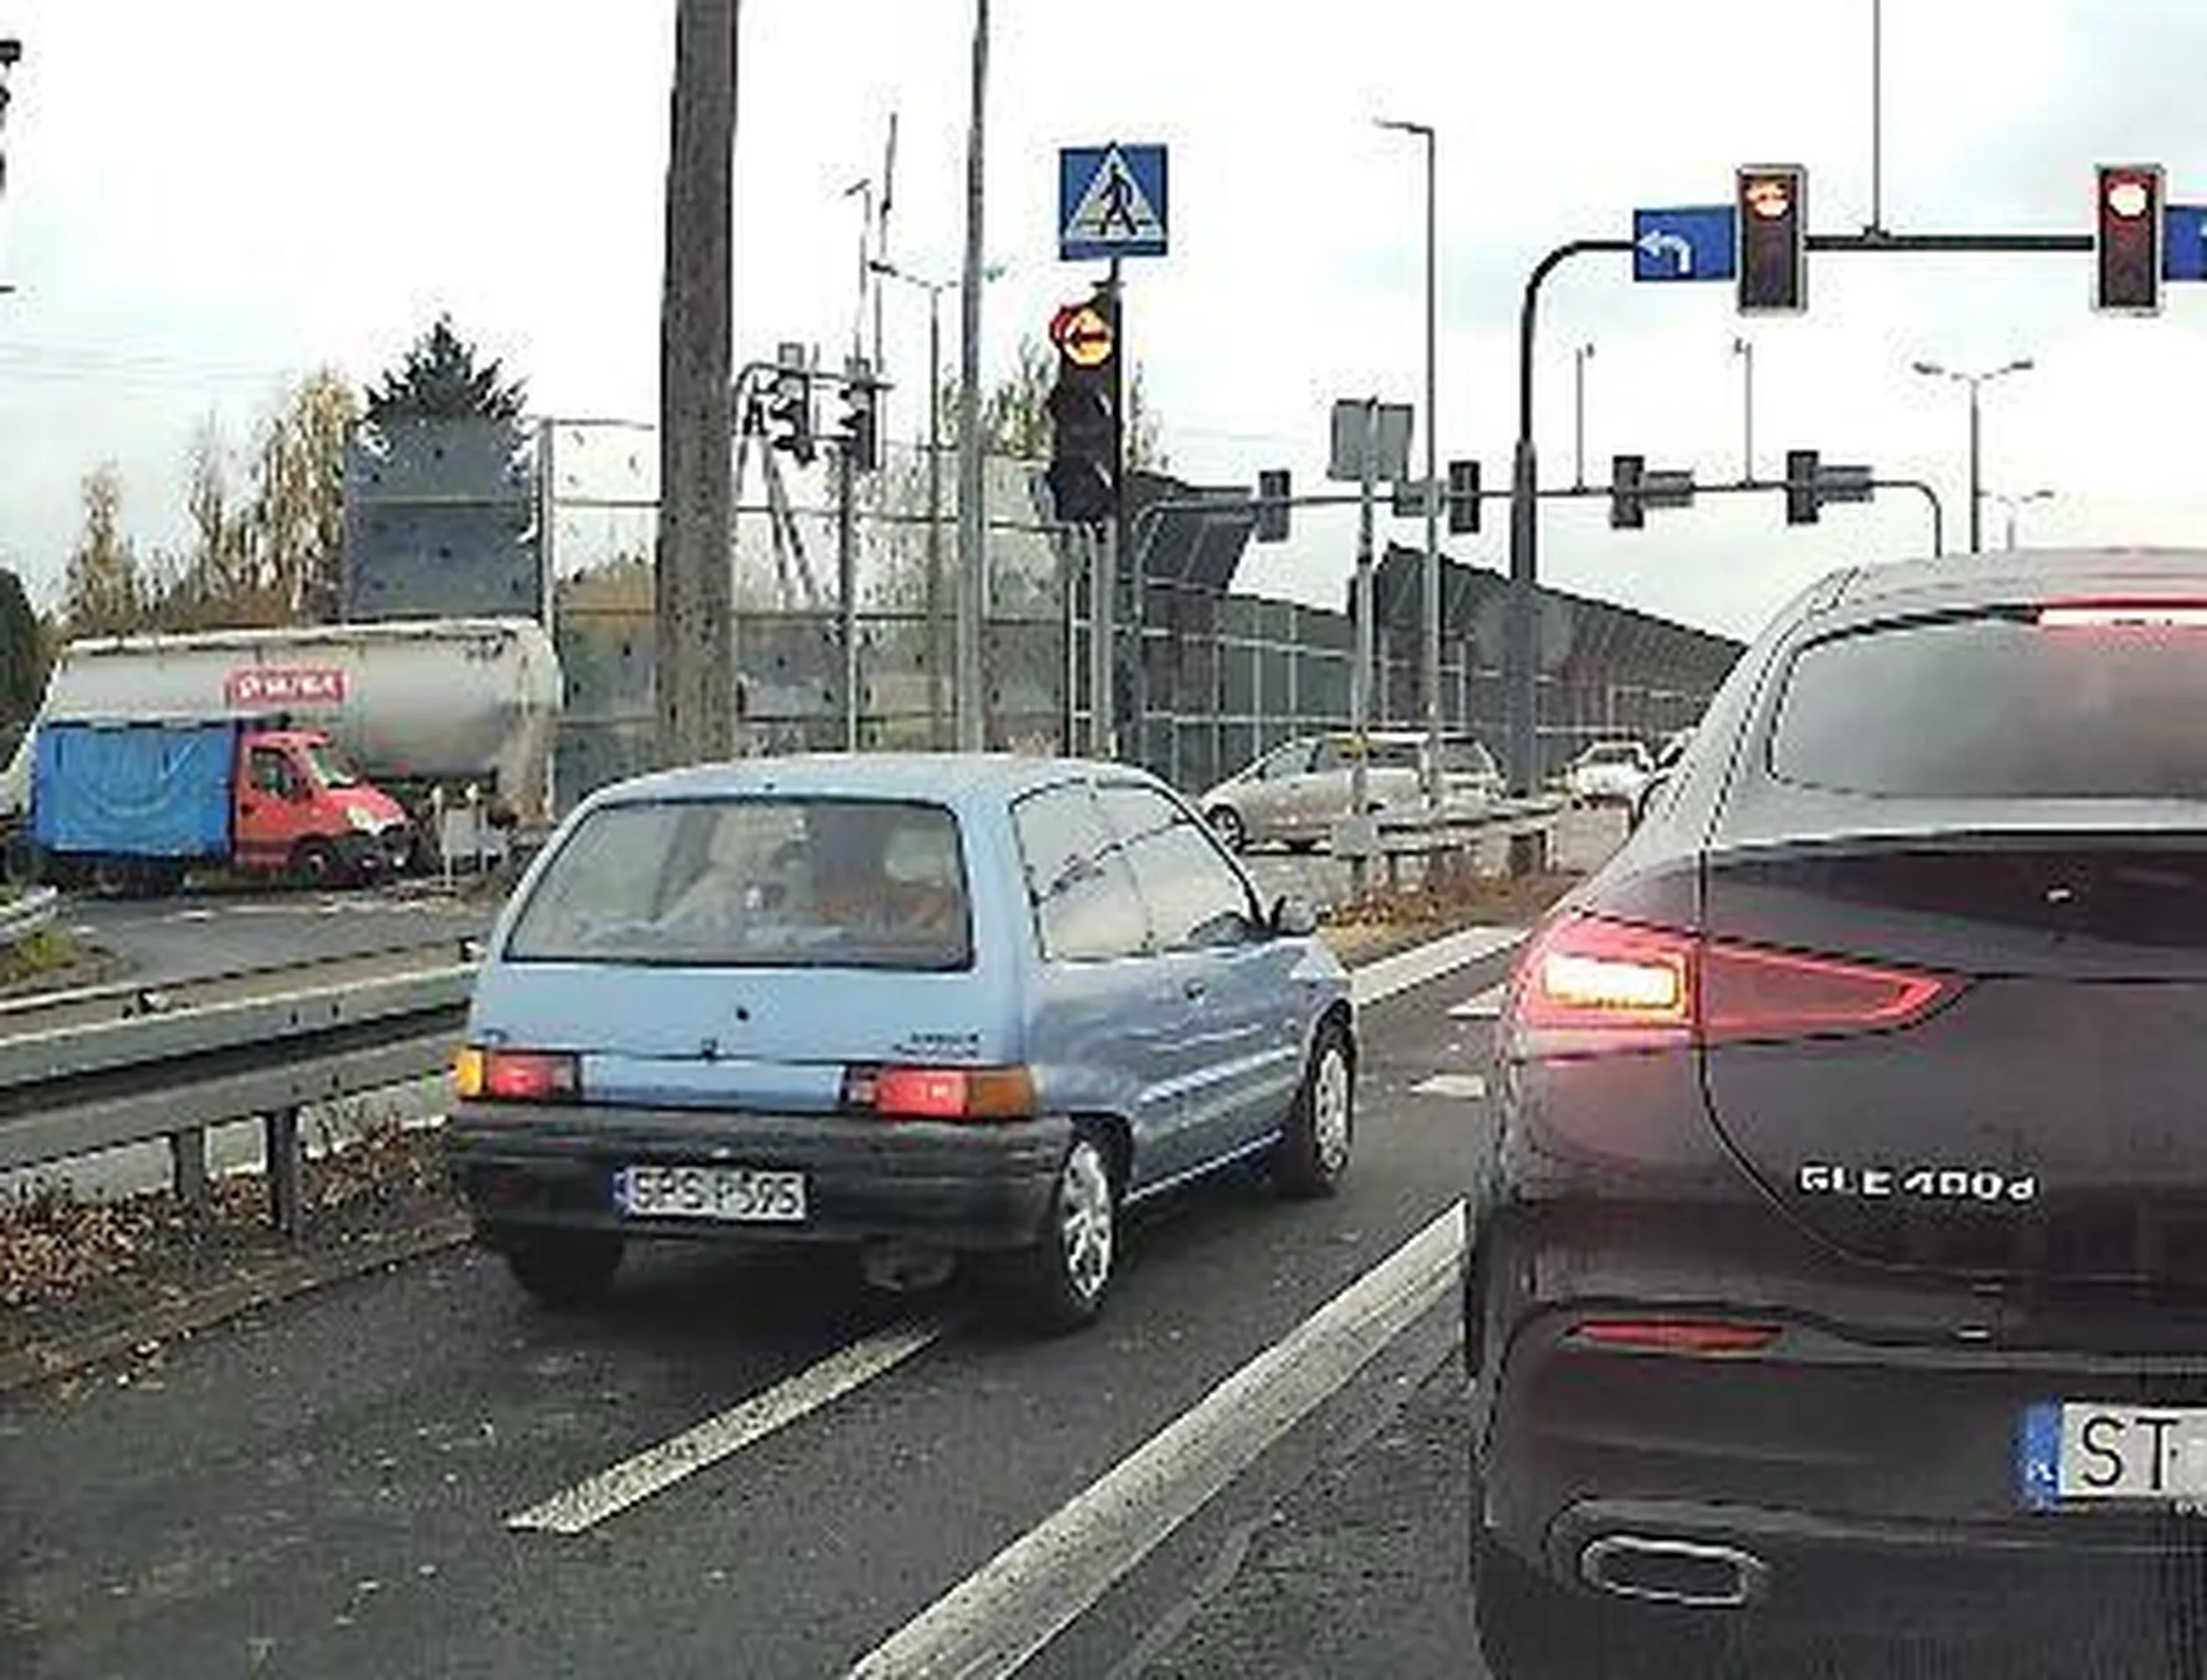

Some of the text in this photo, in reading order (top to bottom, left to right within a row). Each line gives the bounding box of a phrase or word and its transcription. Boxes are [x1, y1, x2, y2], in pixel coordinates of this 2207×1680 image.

[1800, 1166, 2036, 1201] GLE 400d
[2082, 1416, 2181, 1491] ST
